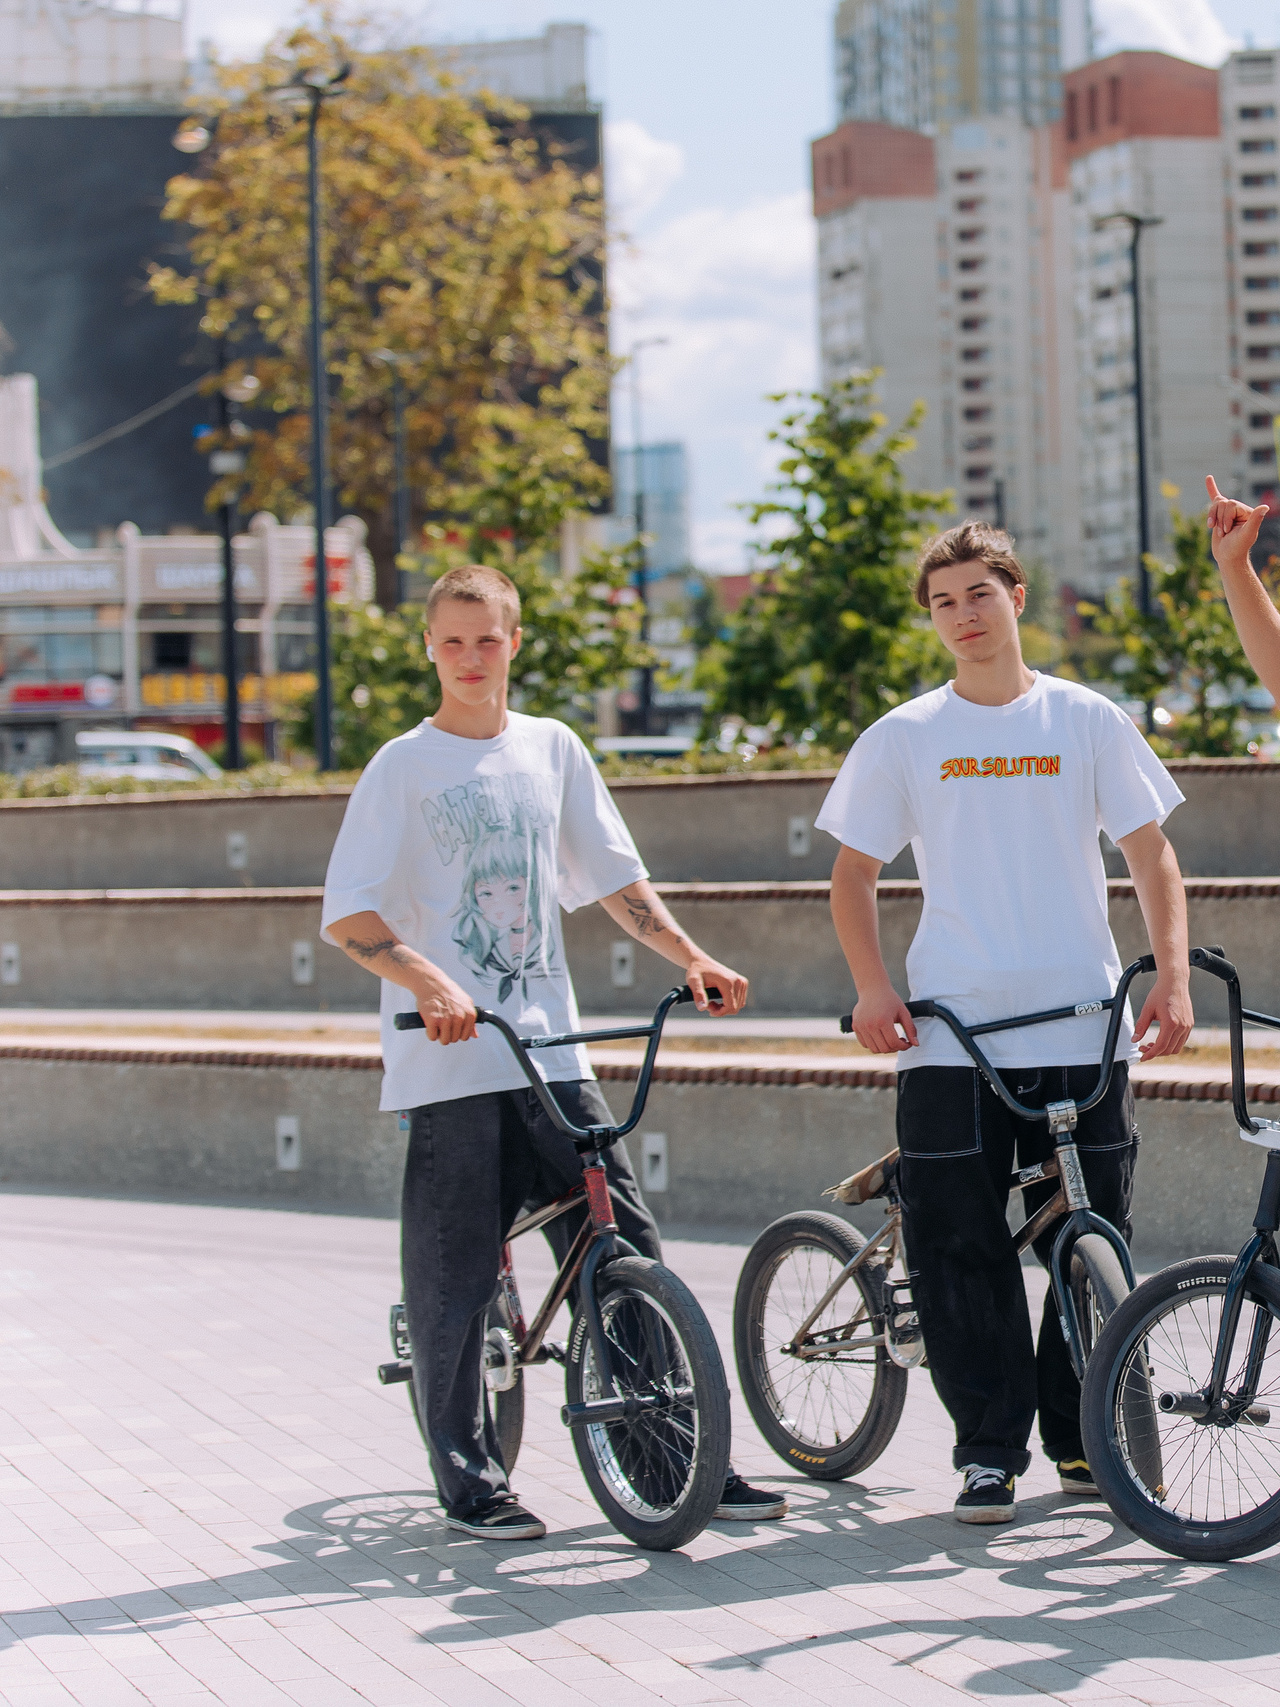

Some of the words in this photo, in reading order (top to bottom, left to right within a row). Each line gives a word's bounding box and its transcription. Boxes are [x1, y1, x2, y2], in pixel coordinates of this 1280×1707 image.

[940, 757, 981, 781] SOUR
[981, 754, 1060, 778] SOLUTION
[1177, 1276, 1231, 1290] MIRAG
[571, 1313, 587, 1363] MIRAG
